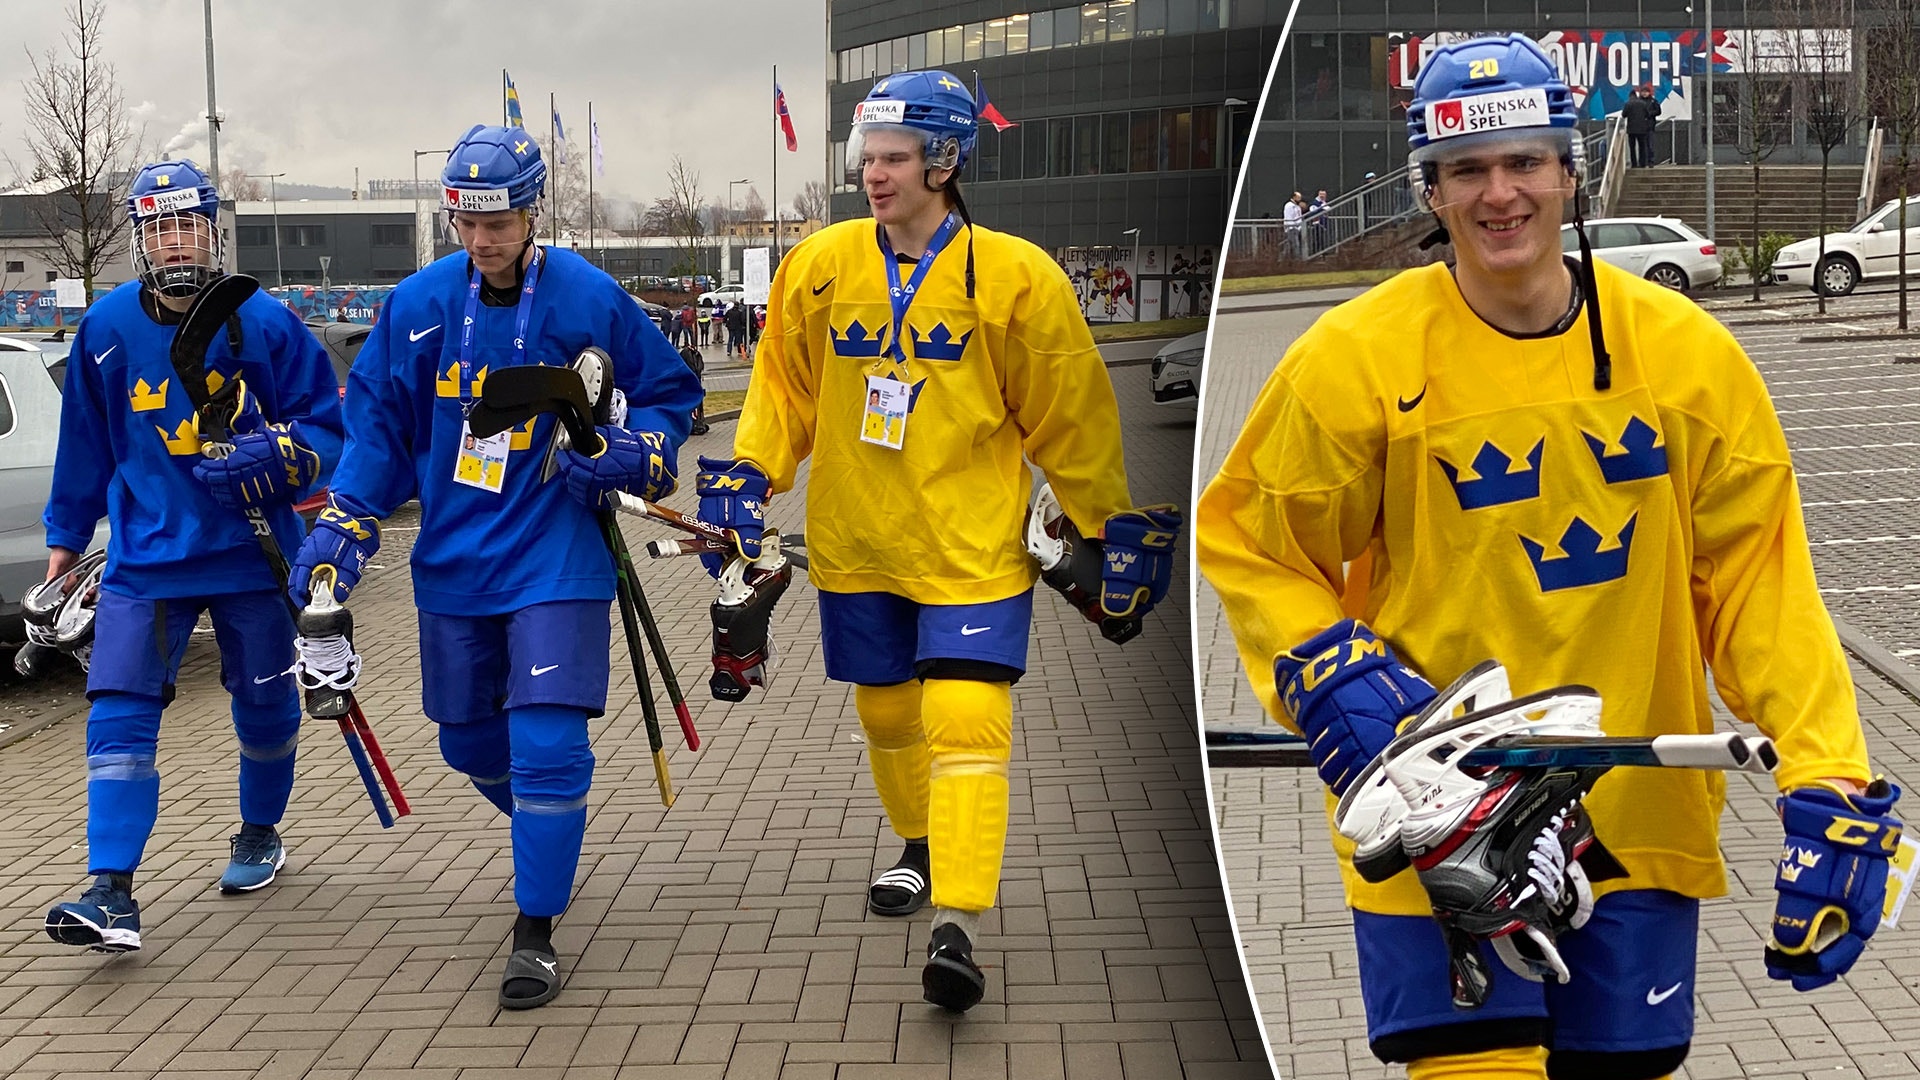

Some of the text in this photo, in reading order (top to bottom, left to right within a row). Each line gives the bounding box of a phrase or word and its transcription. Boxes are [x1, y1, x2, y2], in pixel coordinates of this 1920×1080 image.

[1469, 58, 1498, 80] 20
[1608, 42, 1681, 87] OFF!
[864, 104, 897, 113] SVENSKA
[1468, 98, 1537, 116] SVENSKA
[950, 115, 971, 125] CCM
[1470, 115, 1507, 130] SPEL
[469, 164, 479, 178] 9
[156, 175, 170, 187] 18
[157, 193, 194, 204] SVENSKA
[462, 194, 502, 202] SVENSKA
[463, 202, 483, 210] SPEL
[1066, 250, 1087, 262] LET'S
[1114, 250, 1132, 262] OFF!
[165, 271, 191, 280] CCM
[697, 474, 747, 491] CM
[681, 514, 726, 538] JETSPEED
[1105, 593, 1130, 601] CCM
[1284, 637, 1386, 723] CCM
